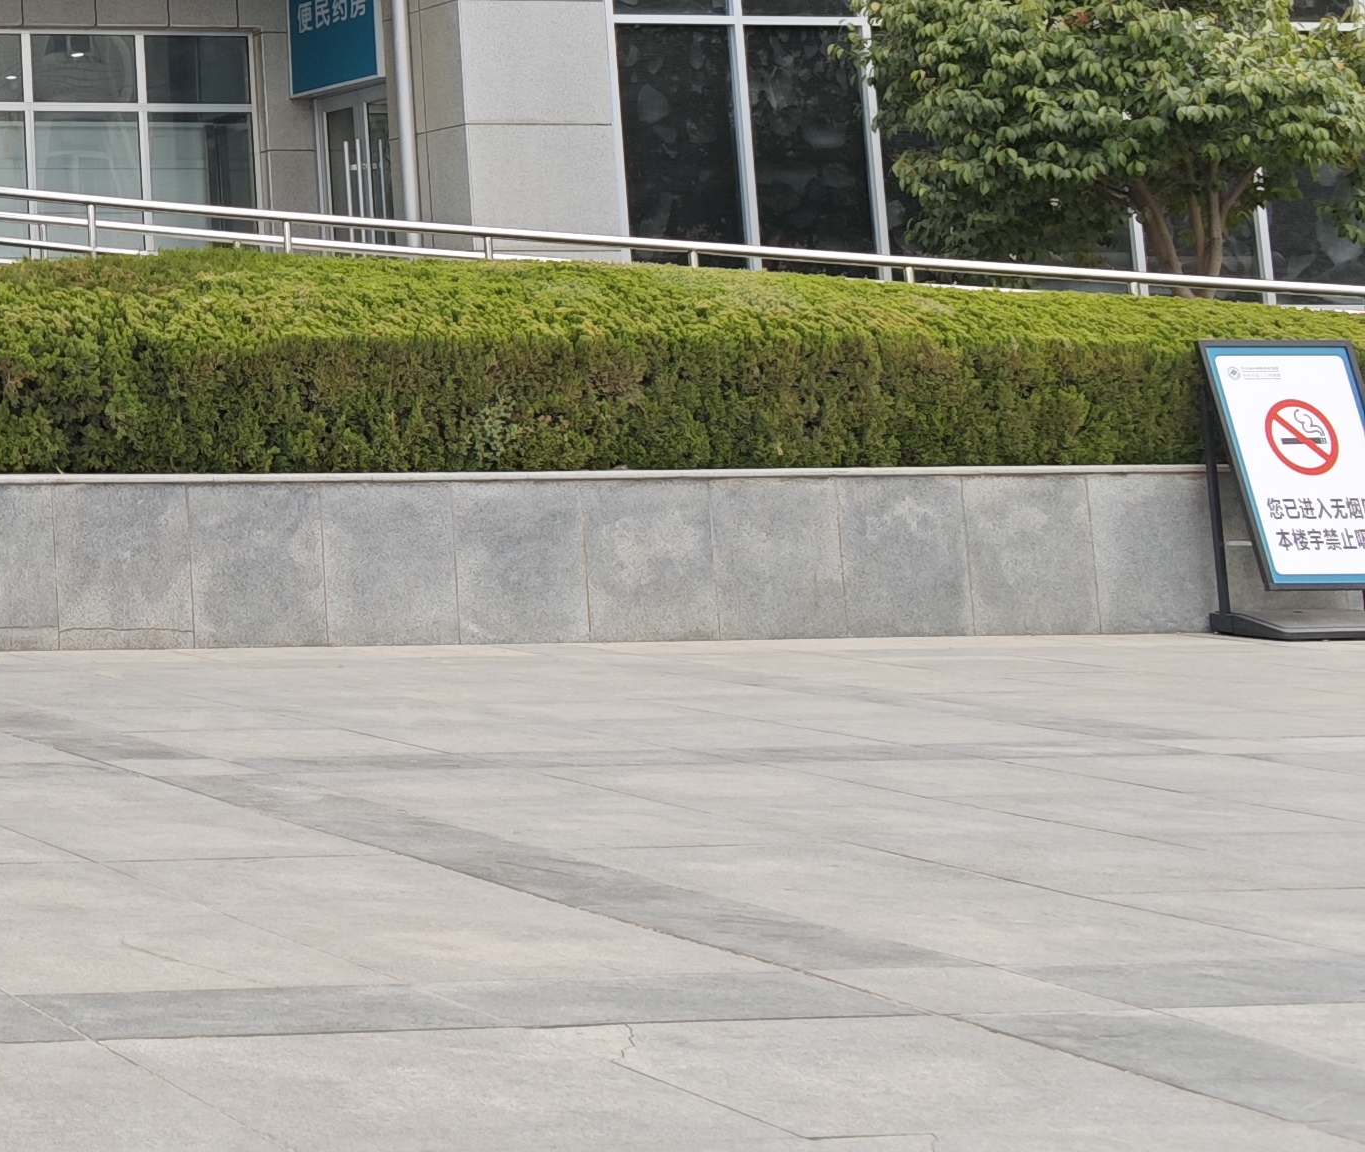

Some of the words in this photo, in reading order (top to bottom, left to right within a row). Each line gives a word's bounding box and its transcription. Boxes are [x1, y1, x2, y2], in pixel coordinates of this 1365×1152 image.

[1266, 497, 1365, 519] 您已进入无烟
